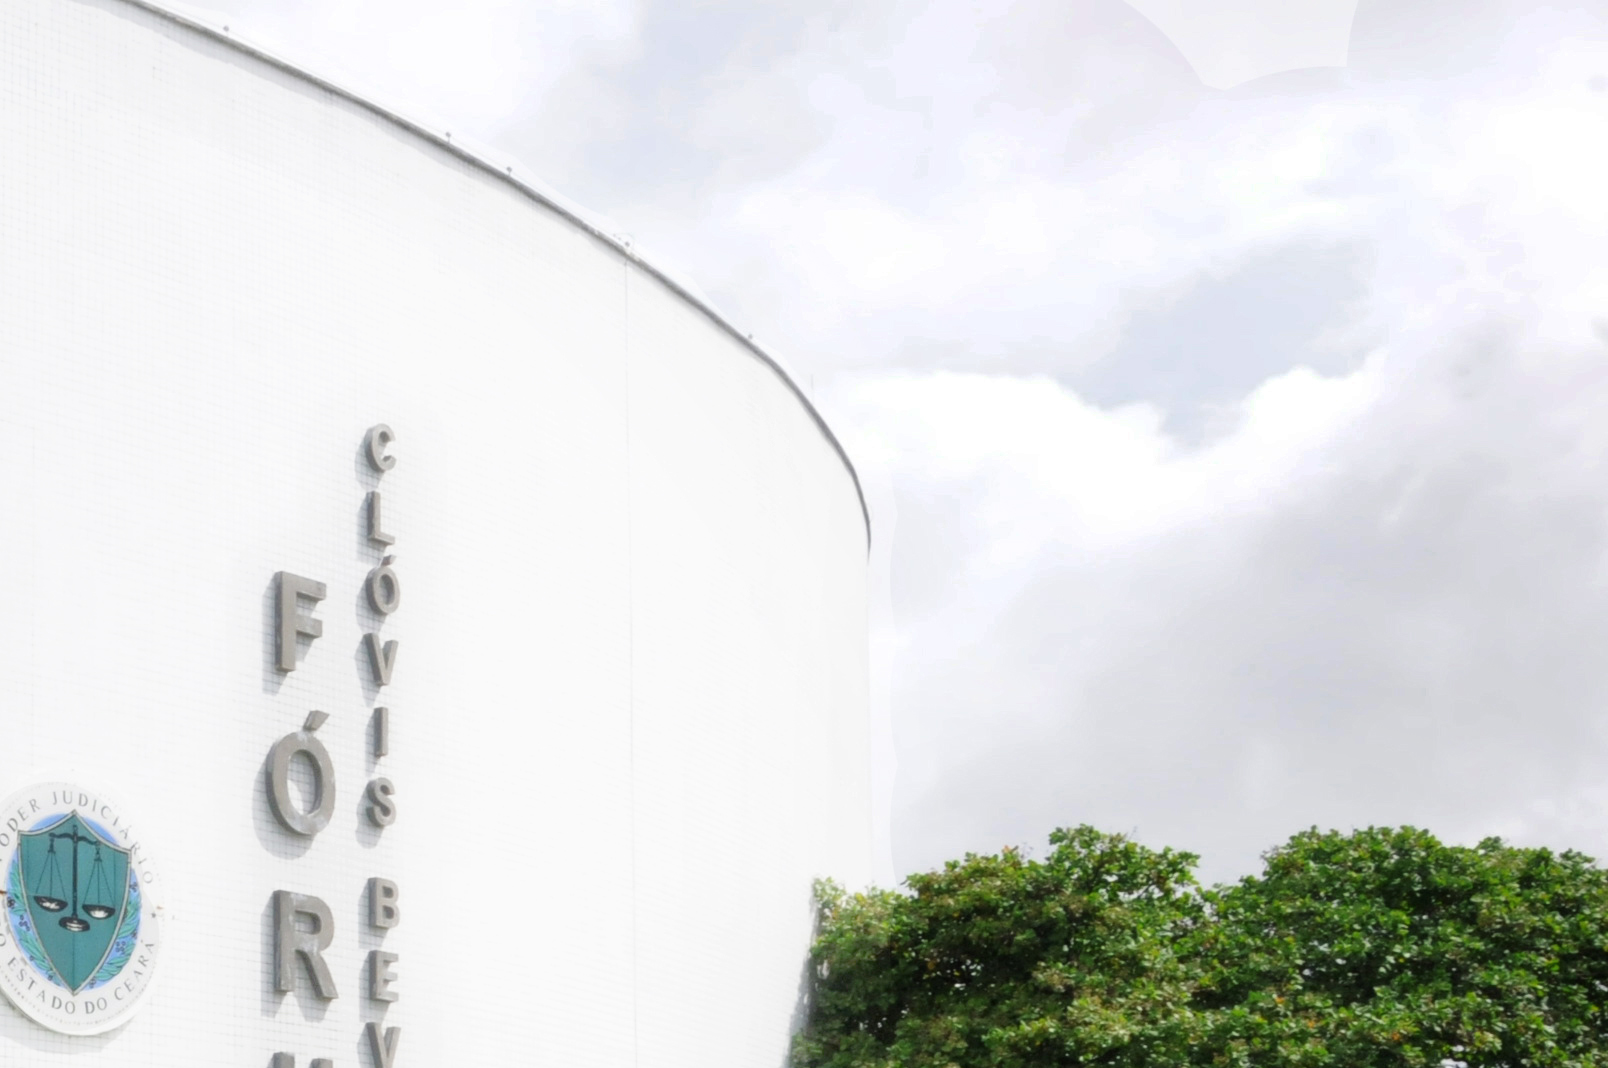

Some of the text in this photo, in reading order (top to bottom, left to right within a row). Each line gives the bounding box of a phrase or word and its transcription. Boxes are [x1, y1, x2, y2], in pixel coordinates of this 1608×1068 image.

[363, 423, 401, 828] CLÓVIS
[52, 790, 154, 885] JUDICIÁRIO
[7, 956, 76, 1014] ESTADO
[85, 1000, 108, 1015] DO
[114, 940, 155, 1001] CEARÁ
